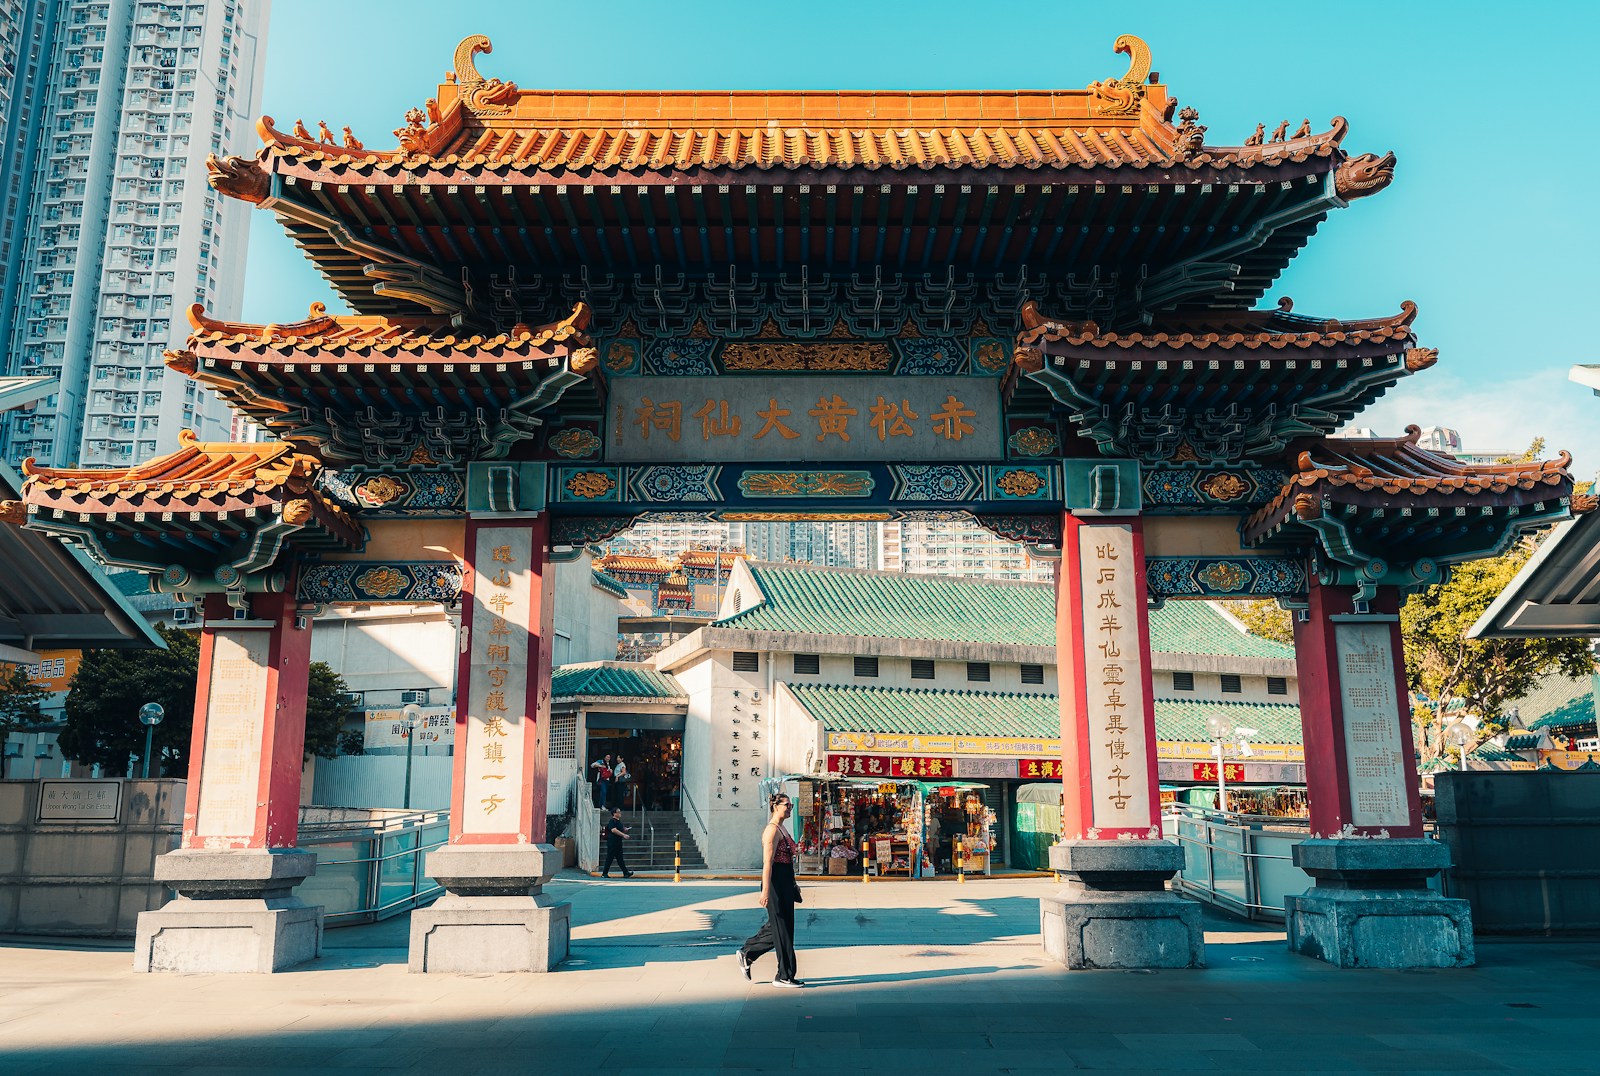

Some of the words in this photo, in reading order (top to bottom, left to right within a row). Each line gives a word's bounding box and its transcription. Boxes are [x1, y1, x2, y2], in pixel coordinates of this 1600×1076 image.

[751, 712, 762, 777] 東華三院
[837, 757, 883, 774] 彭友記
[1201, 763, 1239, 780] 永發
[62, 803, 77, 811] Wong
